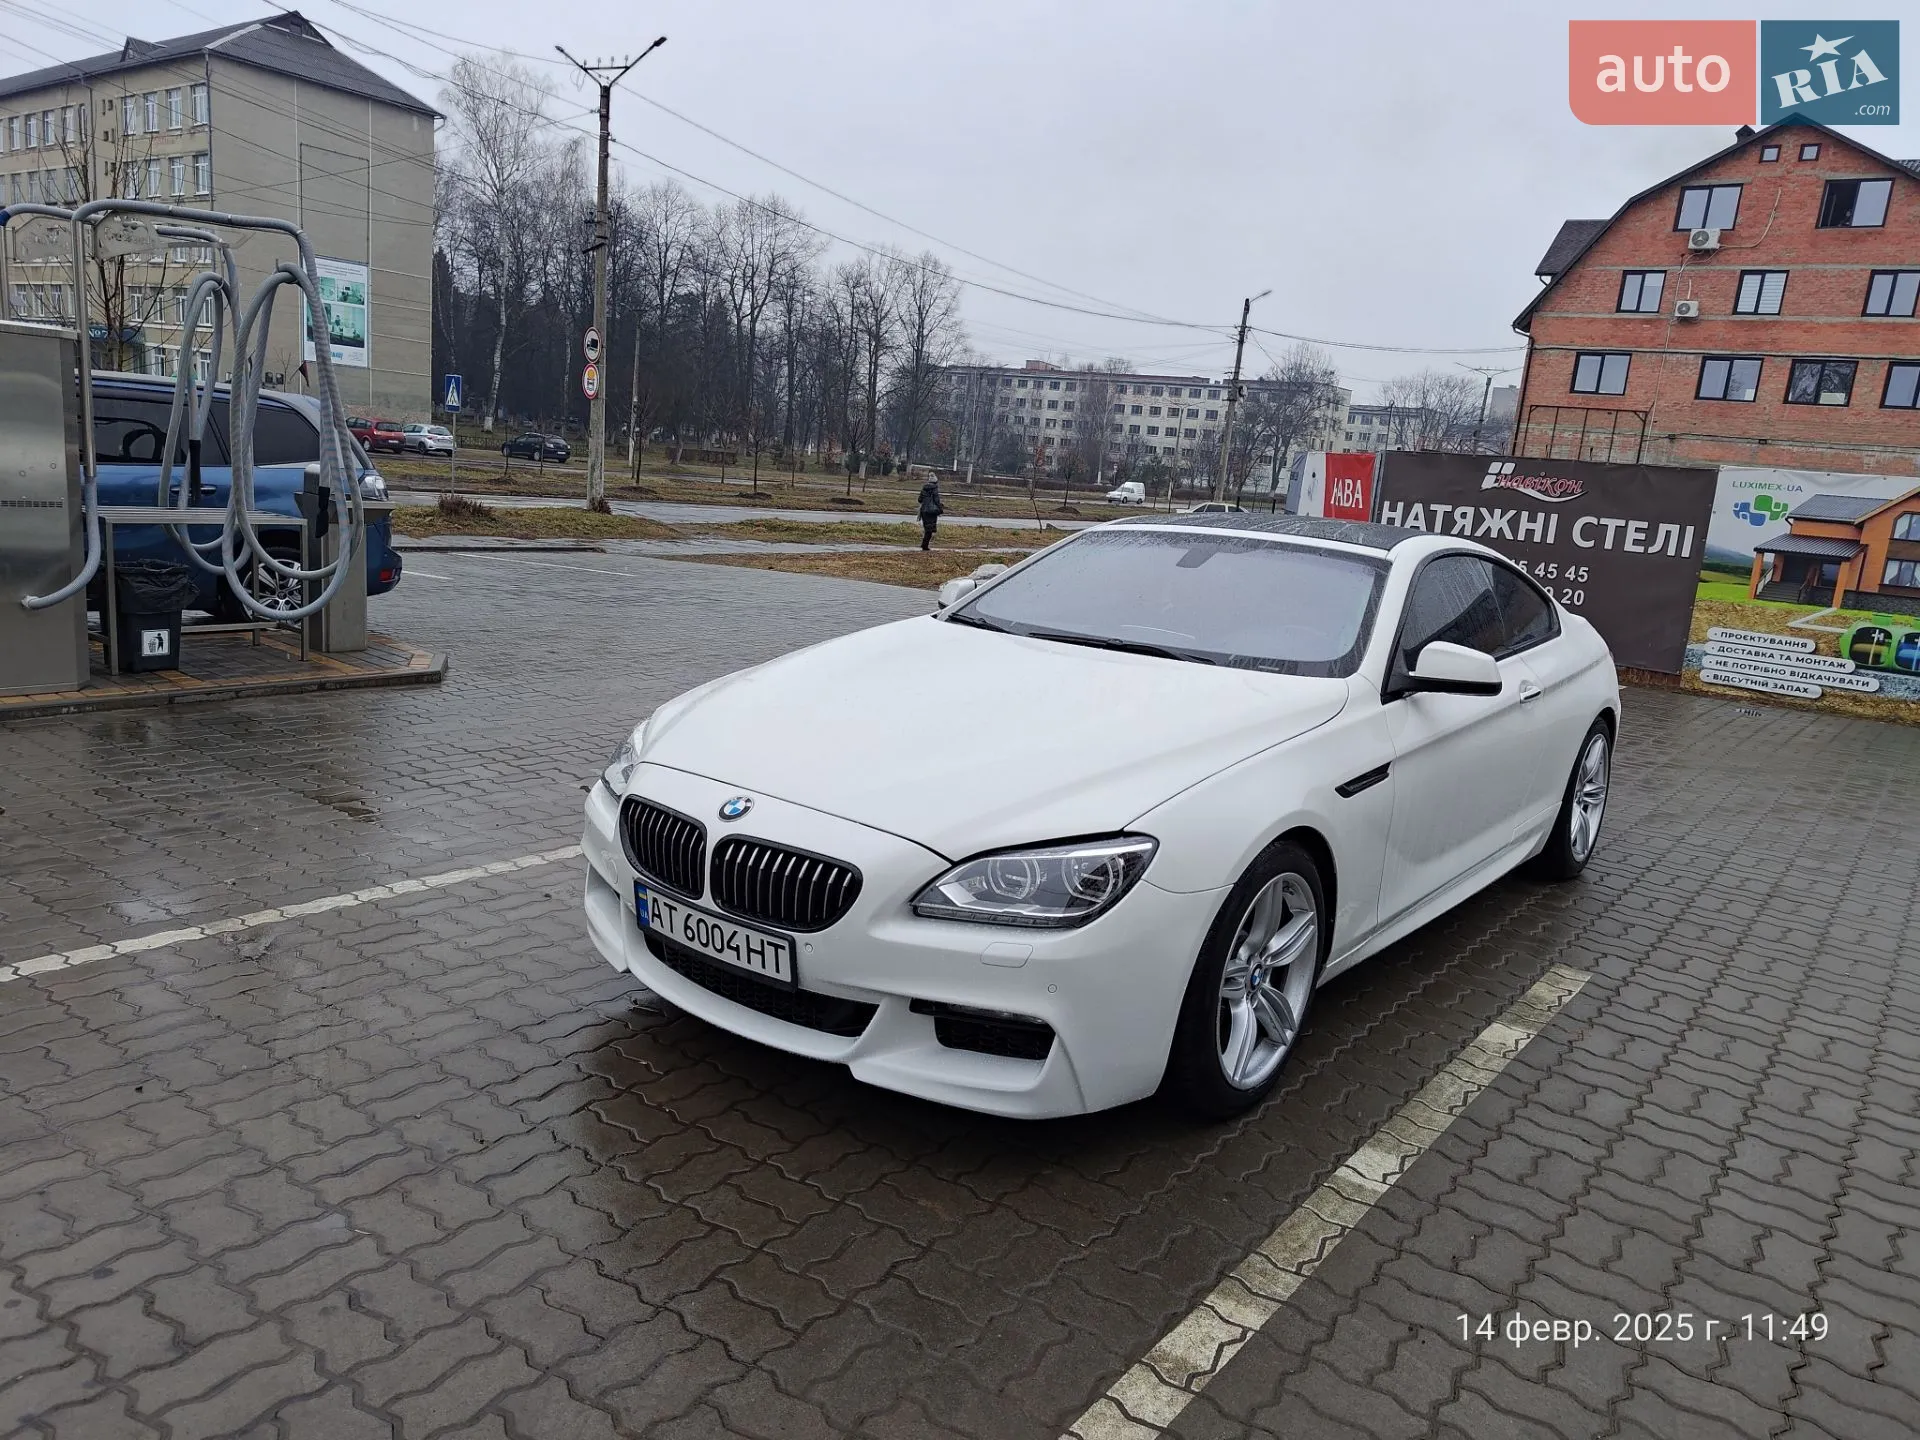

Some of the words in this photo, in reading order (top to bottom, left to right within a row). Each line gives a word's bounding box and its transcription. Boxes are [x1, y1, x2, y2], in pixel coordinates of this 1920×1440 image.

[1732, 481, 1803, 493] LUXIMEX-UA
[1381, 501, 1558, 544] НАТЯЖНІ
[1572, 515, 1695, 558] СТЕЛІ
[1534, 562, 1558, 579] 45
[1564, 565, 1589, 582] 45
[1560, 588, 1585, 606] 20
[1720, 631, 1807, 648] ПРОЄКТУВАННЯ
[1717, 646, 1775, 659] ДОСТАВКА
[1778, 653, 1792, 662] ТА
[1795, 656, 1847, 669] МОНТАЖ
[1712, 673, 1769, 688] ВІДСУТНІЙ
[1771, 682, 1809, 694] ЗАПАХ
[1731, 662, 1786, 676] ПОТРІБНО
[1789, 670, 1869, 687] ВІДКАЧУВАТИ
[651, 896, 678, 935] AT
[683, 912, 741, 962] 6004
[745, 934, 786, 974] HT
